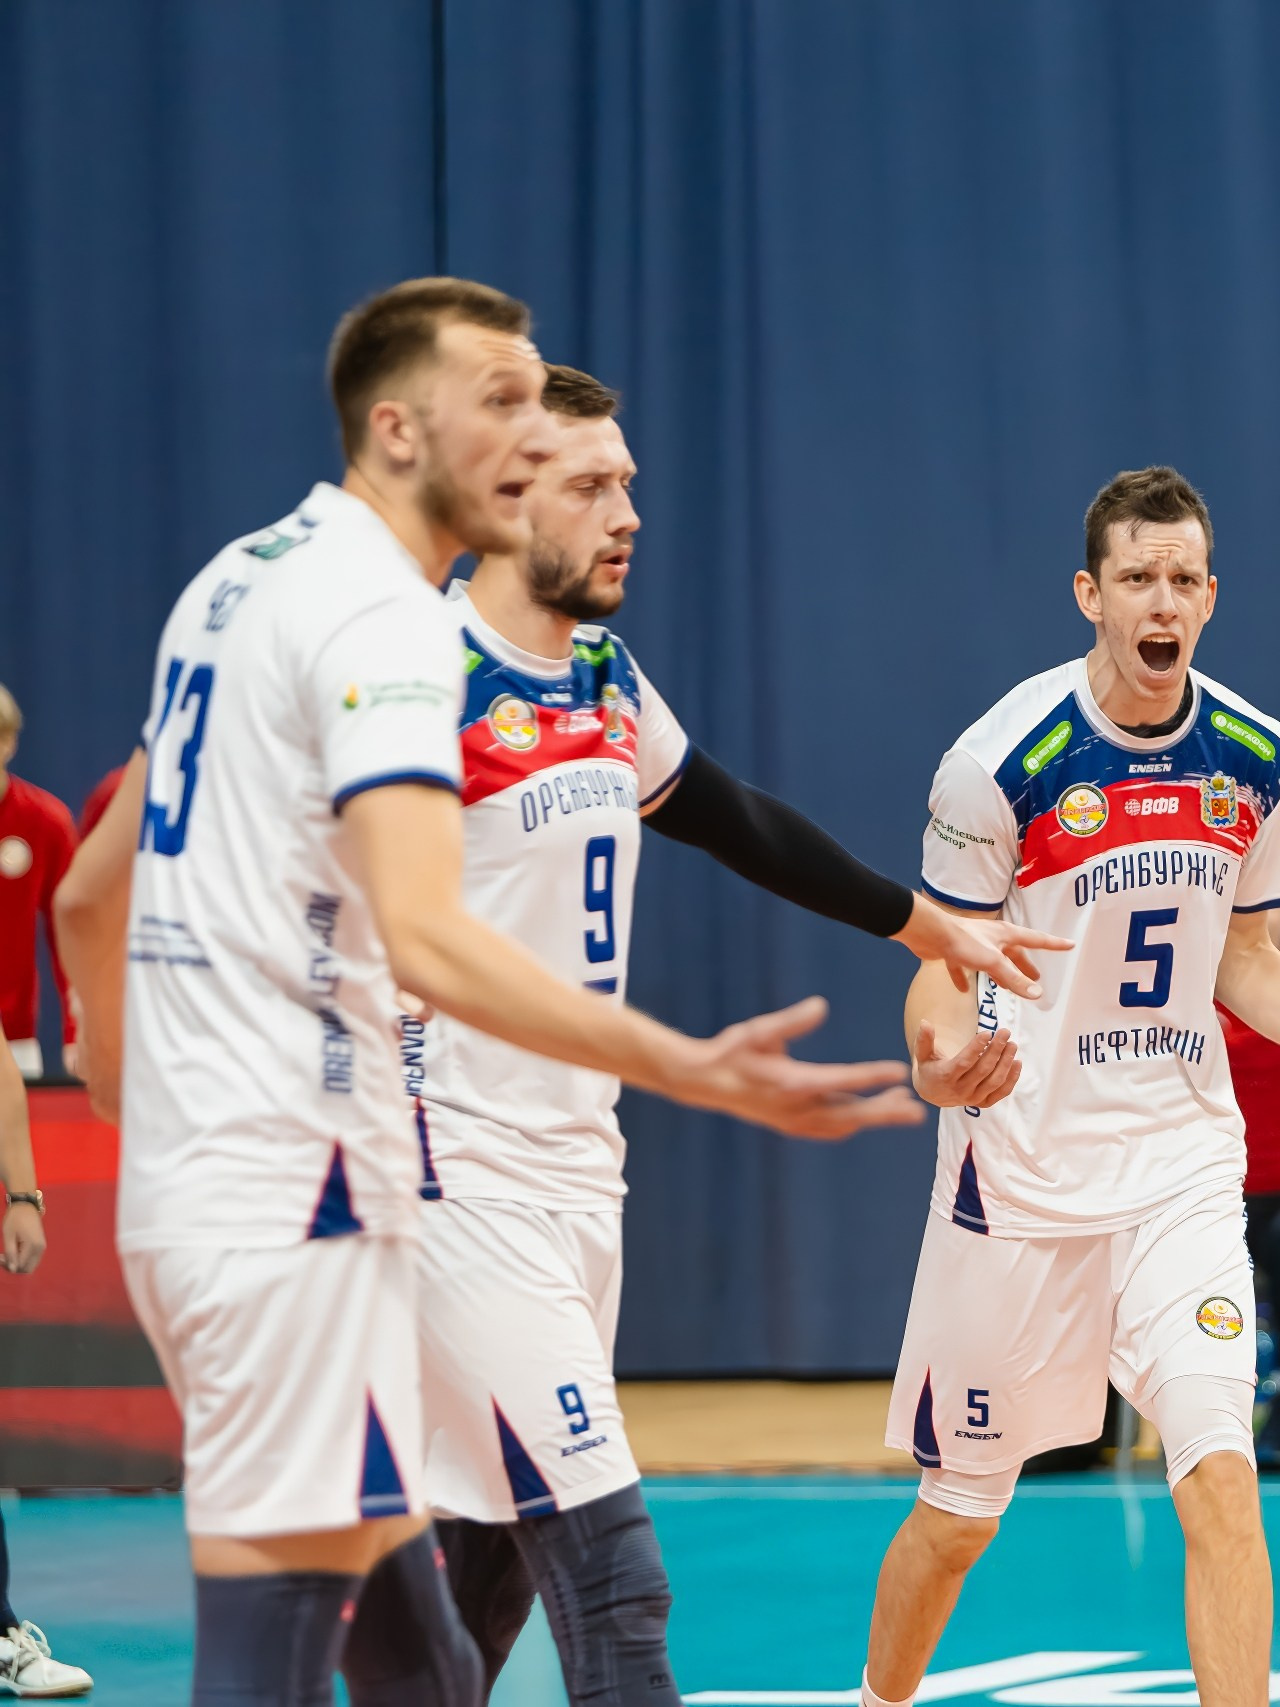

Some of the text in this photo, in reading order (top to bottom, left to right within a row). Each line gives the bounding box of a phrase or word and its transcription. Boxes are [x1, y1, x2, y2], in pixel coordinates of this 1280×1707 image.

[139, 656, 216, 858] 13
[1226, 721, 1272, 757] МЕГАФОН
[1128, 763, 1172, 774] ENSEN
[520, 769, 638, 833] ОРЕНБУРЖ
[1140, 797, 1179, 816] ВФВ
[584, 835, 616, 964] 9
[1119, 907, 1179, 1008] 5
[1078, 1026, 1205, 1066] НЕФТЯНИК
[556, 1383, 590, 1436] 9
[967, 1388, 989, 1428] 5
[955, 1430, 1002, 1440] ENSEN
